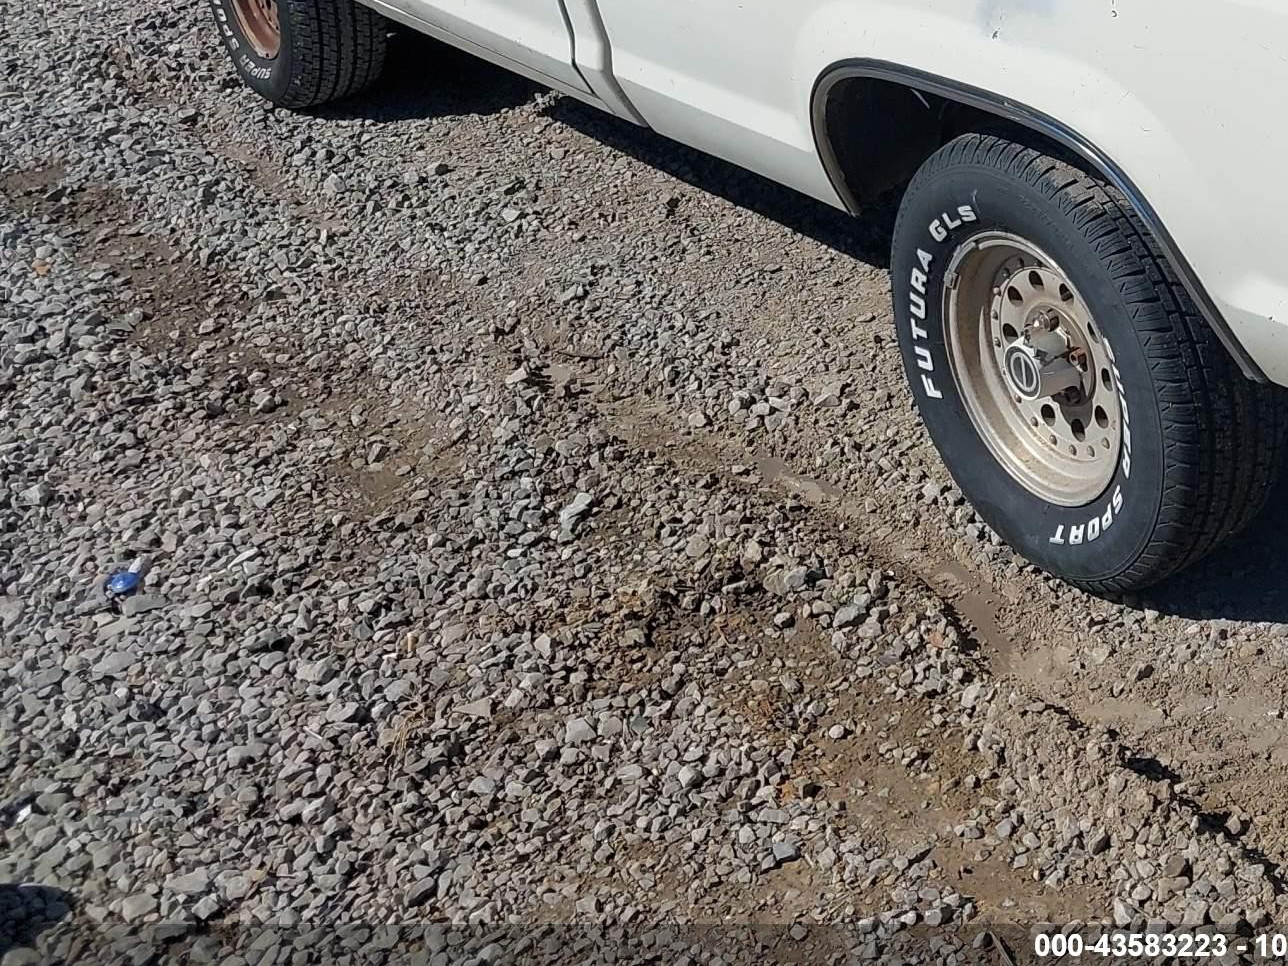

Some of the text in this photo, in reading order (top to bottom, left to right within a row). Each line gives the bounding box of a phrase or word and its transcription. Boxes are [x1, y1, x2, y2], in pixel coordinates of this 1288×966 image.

[239, 53, 273, 80] SUPER
[908, 204, 977, 400] FUTURA GLS
[1049, 484, 1124, 546] SPORT
